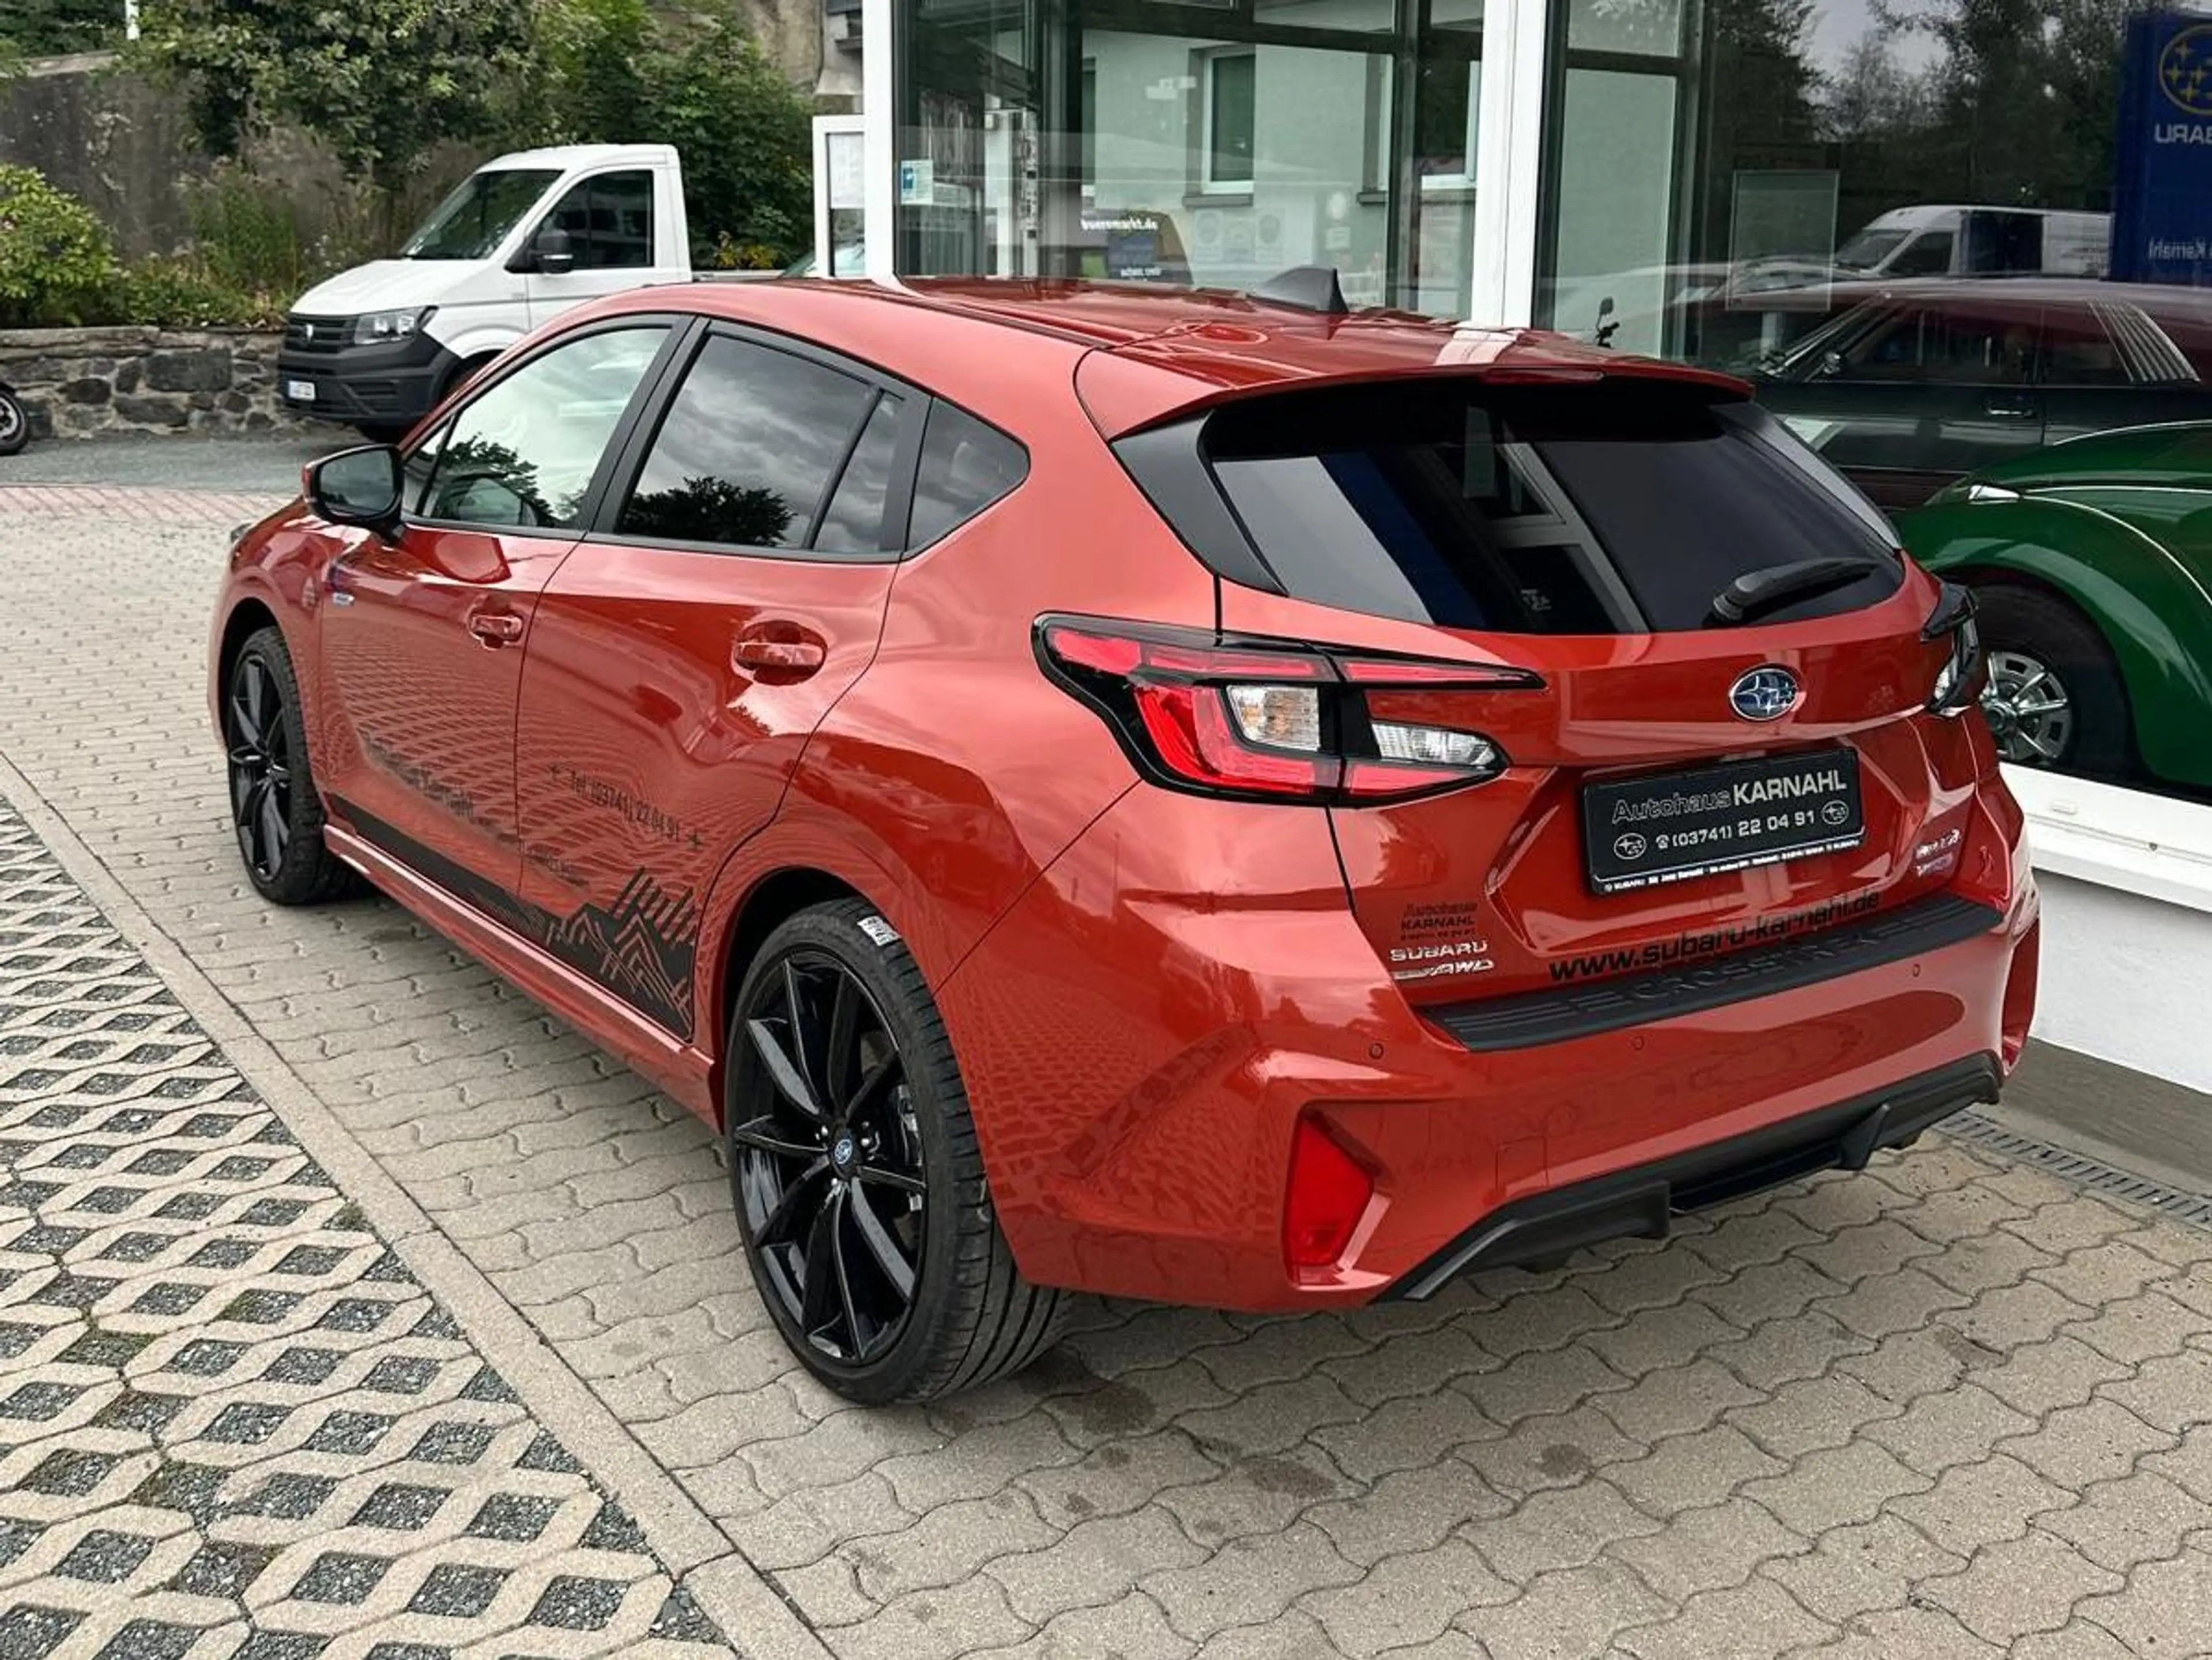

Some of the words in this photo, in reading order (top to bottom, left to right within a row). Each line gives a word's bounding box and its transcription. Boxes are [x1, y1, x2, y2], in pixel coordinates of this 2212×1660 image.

[1611, 790, 1731, 824] Autohaus
[1732, 769, 1848, 806] KARNAHL
[1672, 825, 1732, 847] (03741)
[1738, 819, 1762, 836] 22
[1767, 814, 1789, 830] 04
[1794, 810, 1815, 826] 91
[1390, 940, 1489, 961] SUBARU
[1549, 888, 1880, 981] www.subaru-karnahl.de
